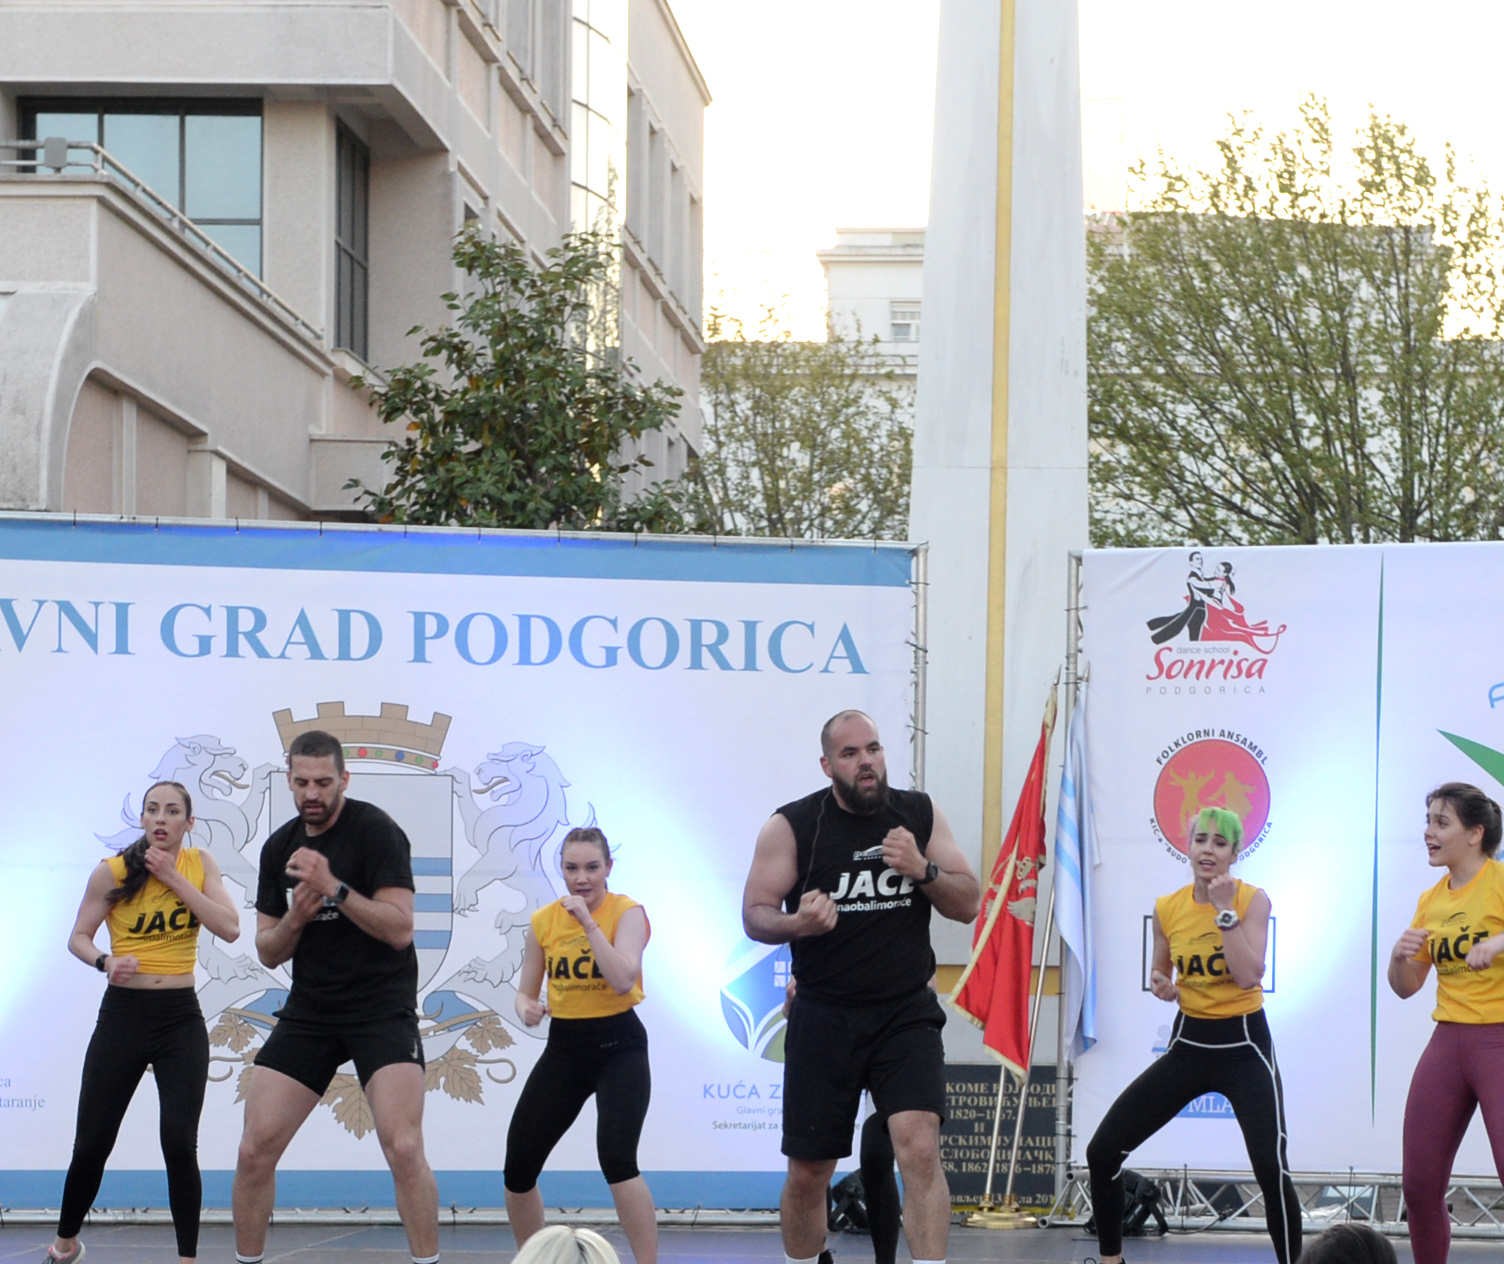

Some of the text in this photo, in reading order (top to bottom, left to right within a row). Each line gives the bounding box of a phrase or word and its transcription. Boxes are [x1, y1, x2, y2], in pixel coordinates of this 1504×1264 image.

[160, 602, 383, 662] GRAD
[407, 610, 870, 675] PODGORICA
[1176, 646, 1231, 655] dance school
[1146, 646, 1269, 681] Sonrisa
[1145, 685, 1266, 695] PODGORICA
[1156, 728, 1269, 766] FOLKLORNI ANSAMBL
[1238, 821, 1273, 862] ODGORICA
[703, 1080, 761, 1099] KUĆA
[737, 1106, 783, 1117] Glavni gra
[1188, 1096, 1235, 1113] MLA
[712, 1120, 766, 1132] Sekretarijat
